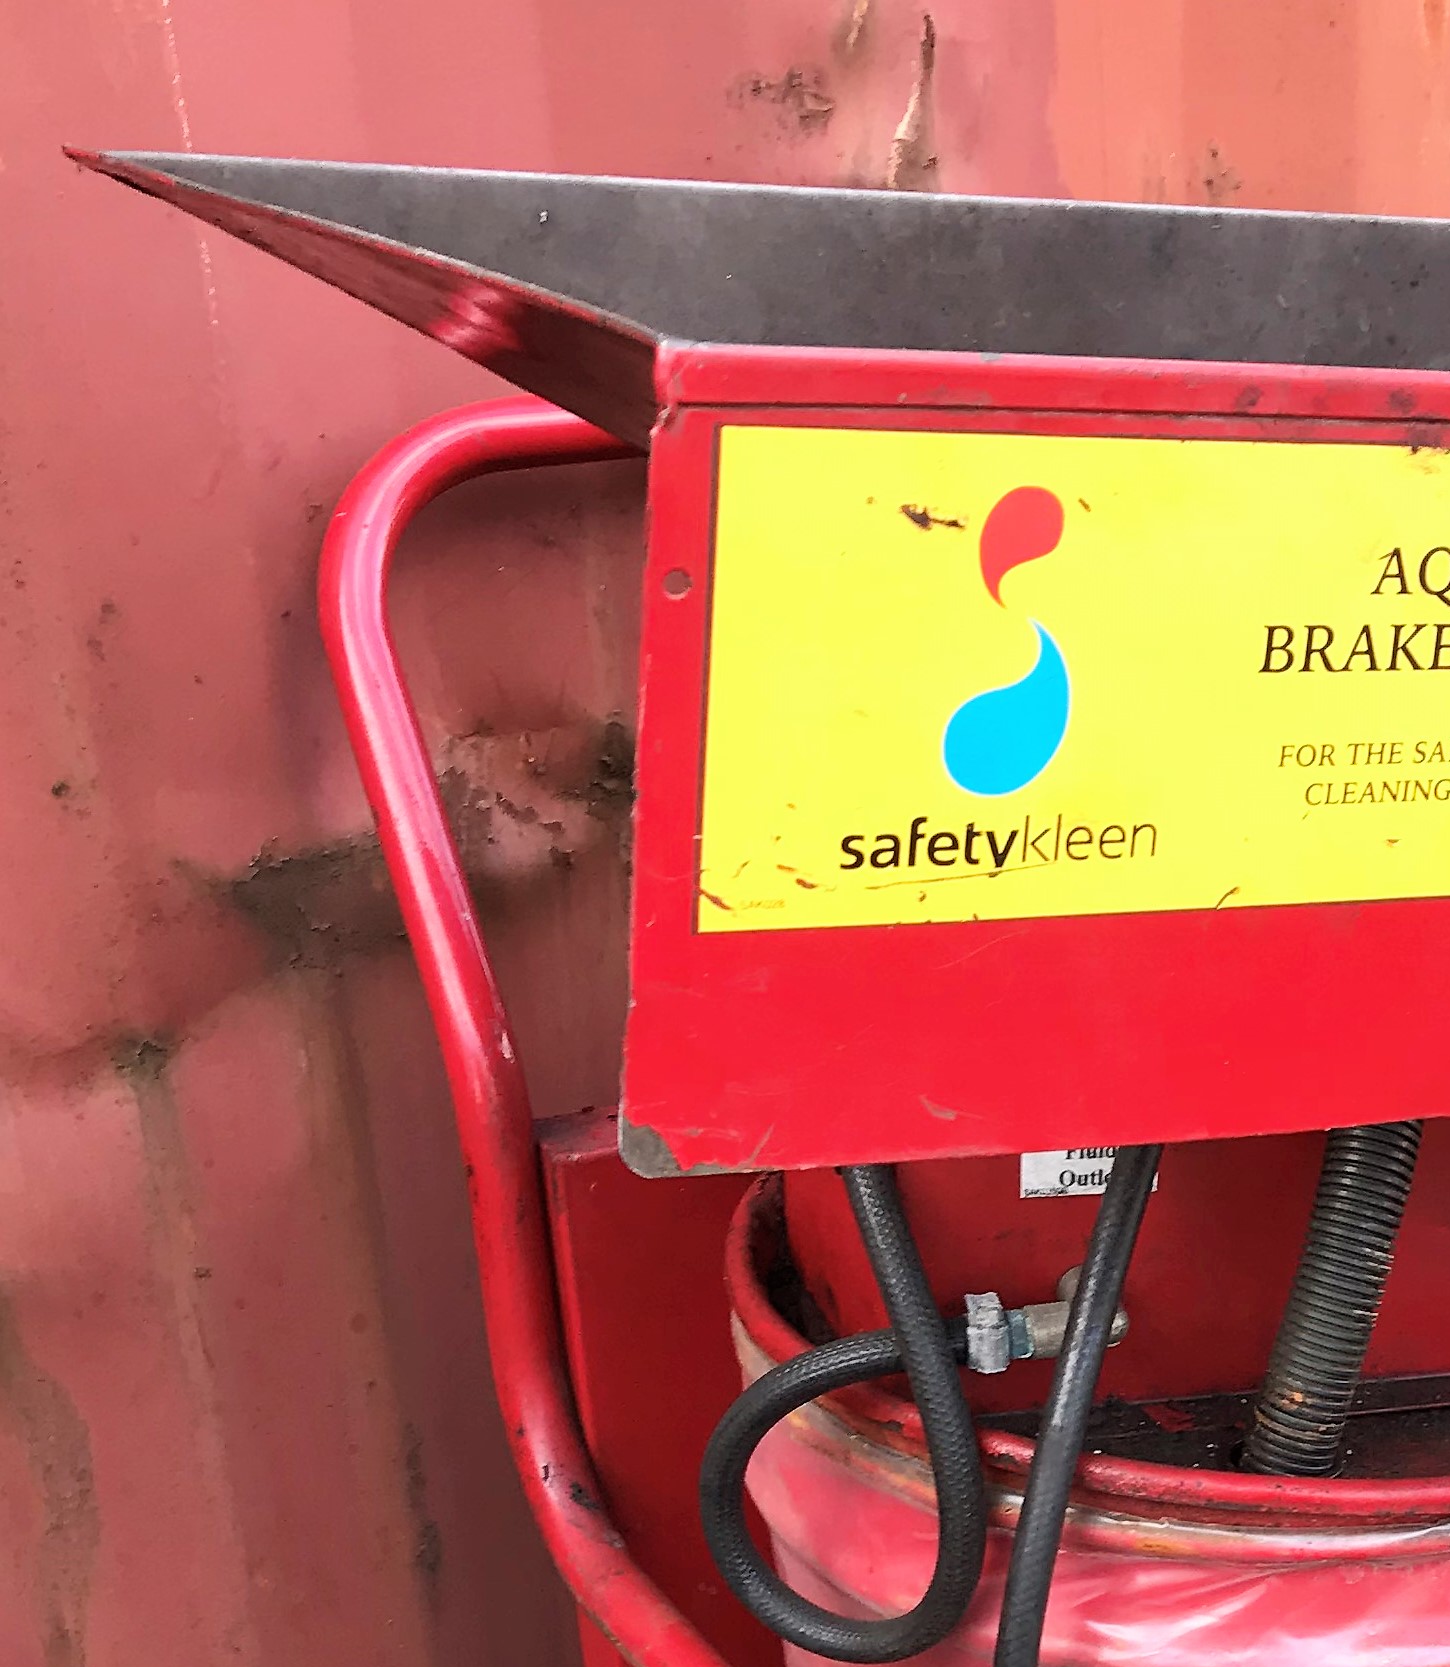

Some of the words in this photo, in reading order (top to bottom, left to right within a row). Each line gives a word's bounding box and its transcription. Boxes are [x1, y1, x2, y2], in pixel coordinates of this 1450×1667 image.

[1277, 743, 1336, 768] FOR
[1346, 741, 1404, 766] THE
[840, 813, 1158, 876] safetykleen
[1059, 1169, 1112, 1188] Outle
